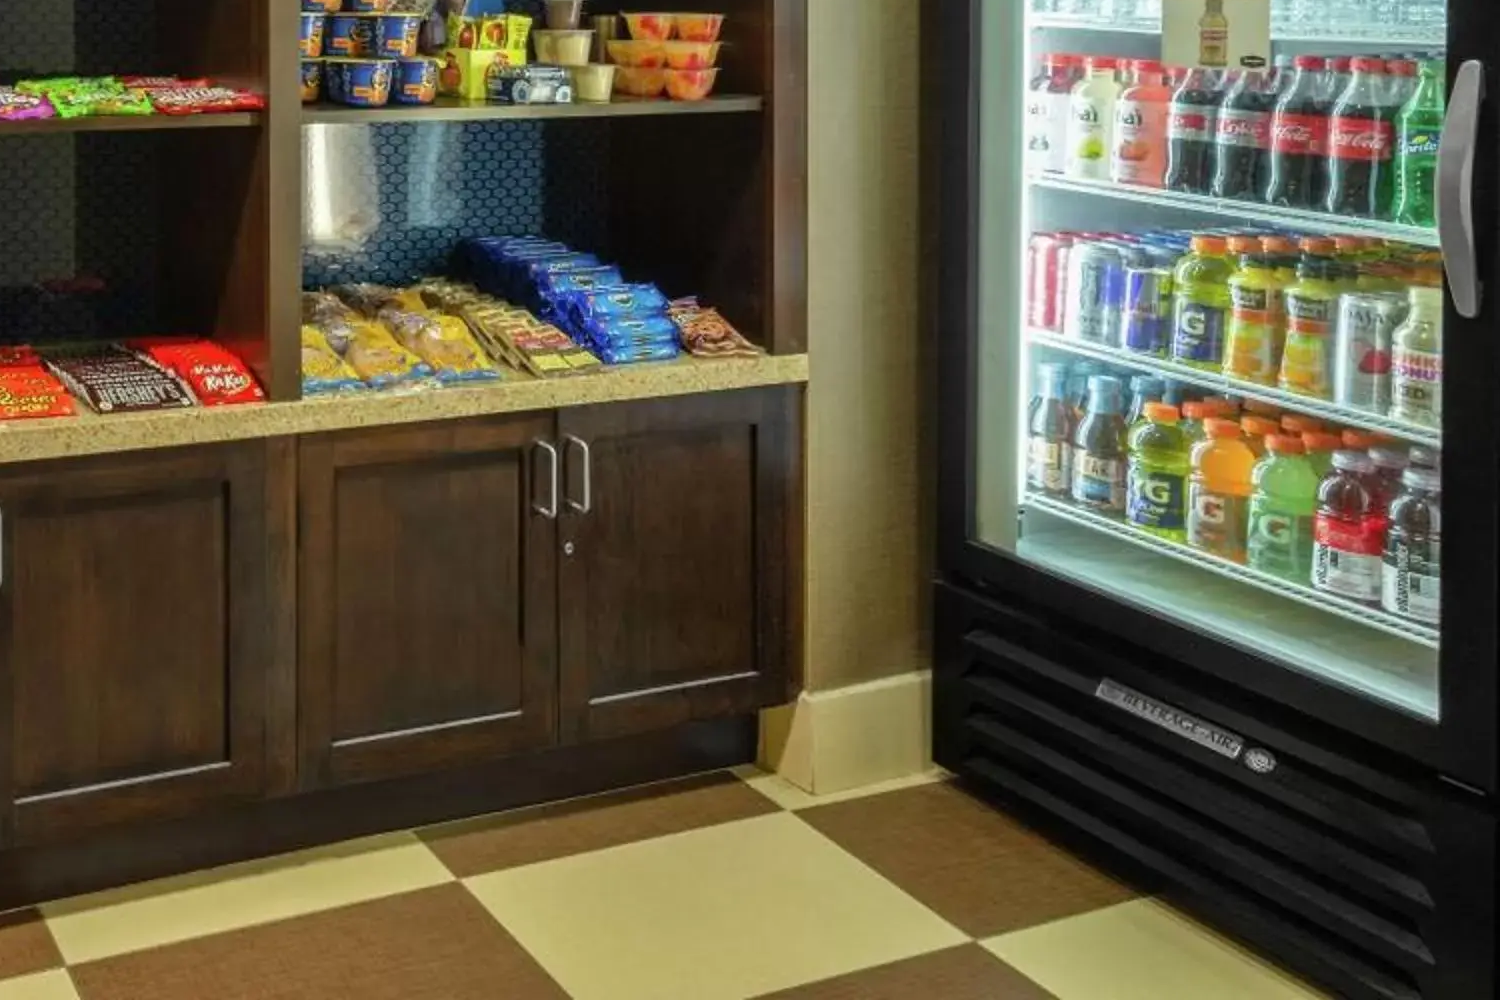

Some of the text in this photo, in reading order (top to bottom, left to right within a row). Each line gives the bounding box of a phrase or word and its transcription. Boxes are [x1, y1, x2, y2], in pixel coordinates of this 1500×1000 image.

[1182, 310, 1206, 336] G
[97, 383, 181, 405] HERSHEY'S
[1145, 480, 1171, 504] G
[1259, 514, 1291, 544] G
